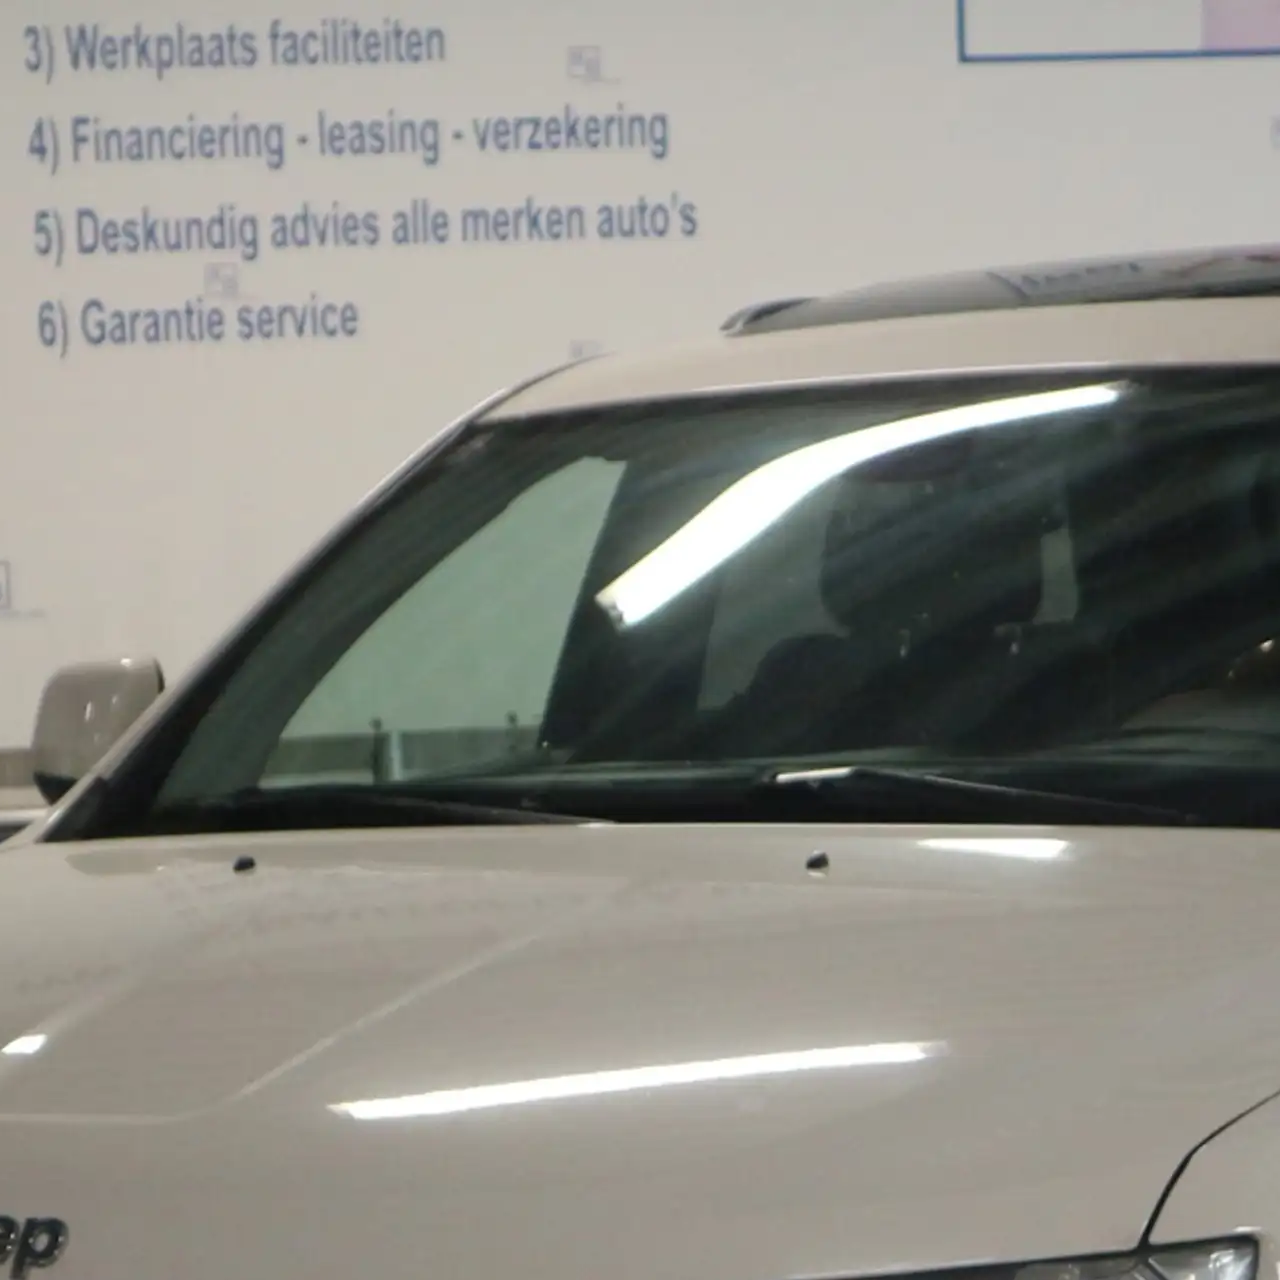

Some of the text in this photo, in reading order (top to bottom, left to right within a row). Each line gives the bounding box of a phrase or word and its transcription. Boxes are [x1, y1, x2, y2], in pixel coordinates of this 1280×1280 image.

[24, 18, 446, 85] 3) Werkplaats faciliteiten
[28, 116, 60, 176] 4)
[70, 112, 285, 171] Financiering
[317, 108, 441, 167] leasing
[473, 103, 669, 161] verzekering
[34, 192, 699, 267] 5) Deskundig advies alle merken auto's
[38, 296, 359, 359] 6) Garantie service
